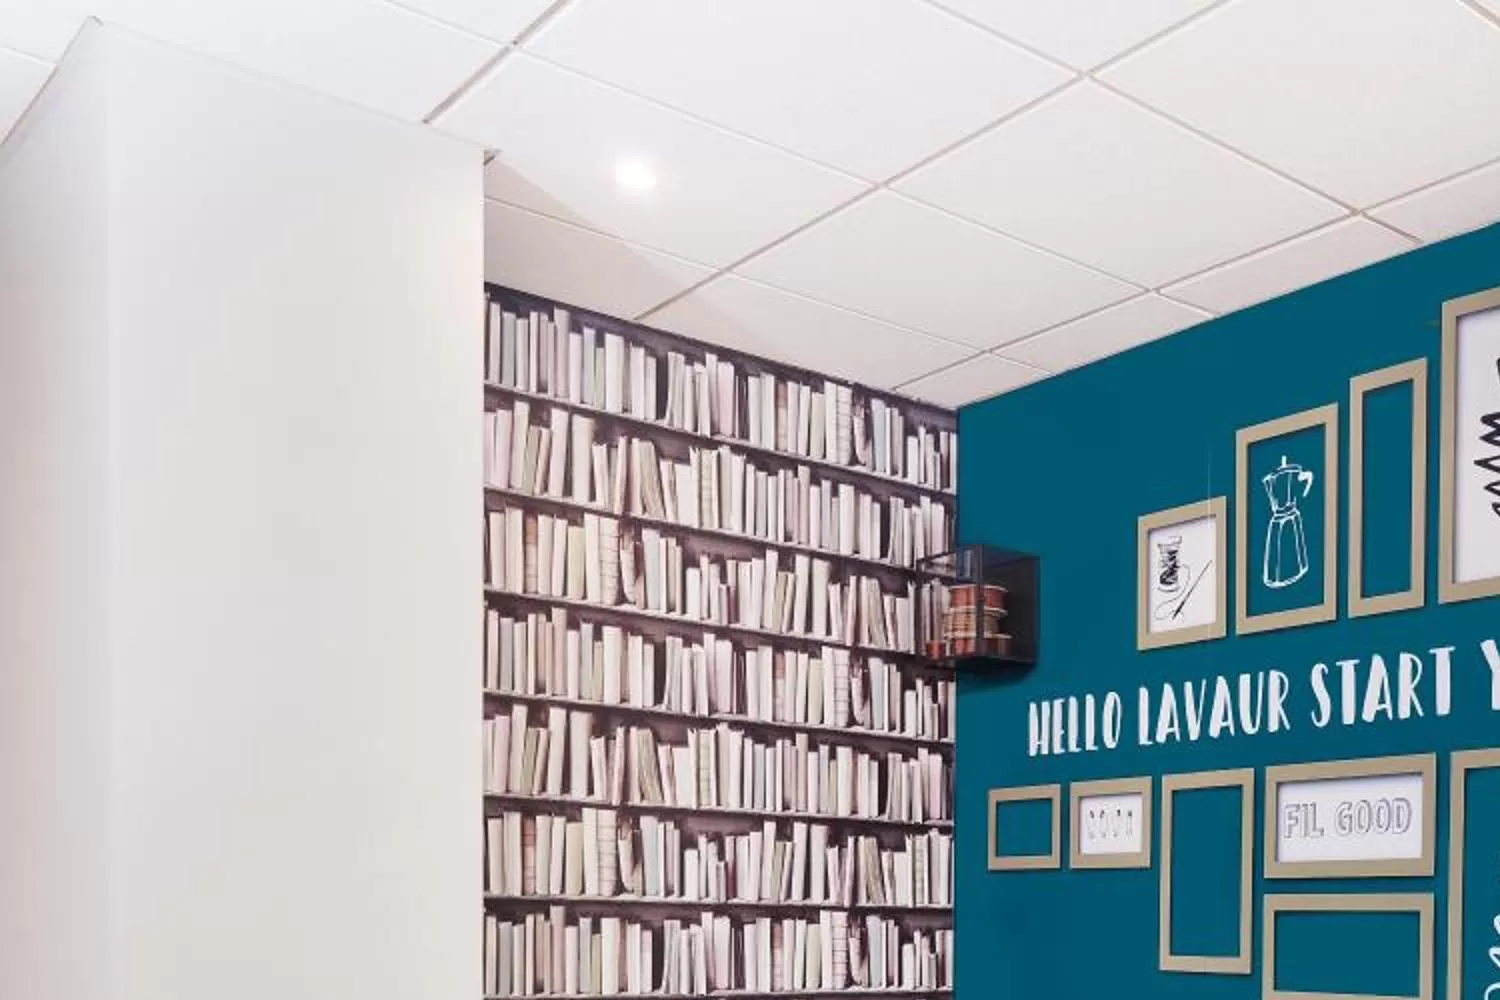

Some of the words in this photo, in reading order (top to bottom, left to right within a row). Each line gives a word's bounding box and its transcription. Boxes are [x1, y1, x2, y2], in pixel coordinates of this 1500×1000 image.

[1028, 691, 1122, 757] HELLO
[1138, 670, 1290, 745] LAVAUR
[1310, 646, 1456, 728] START
[1335, 797, 1412, 836] GOOD
